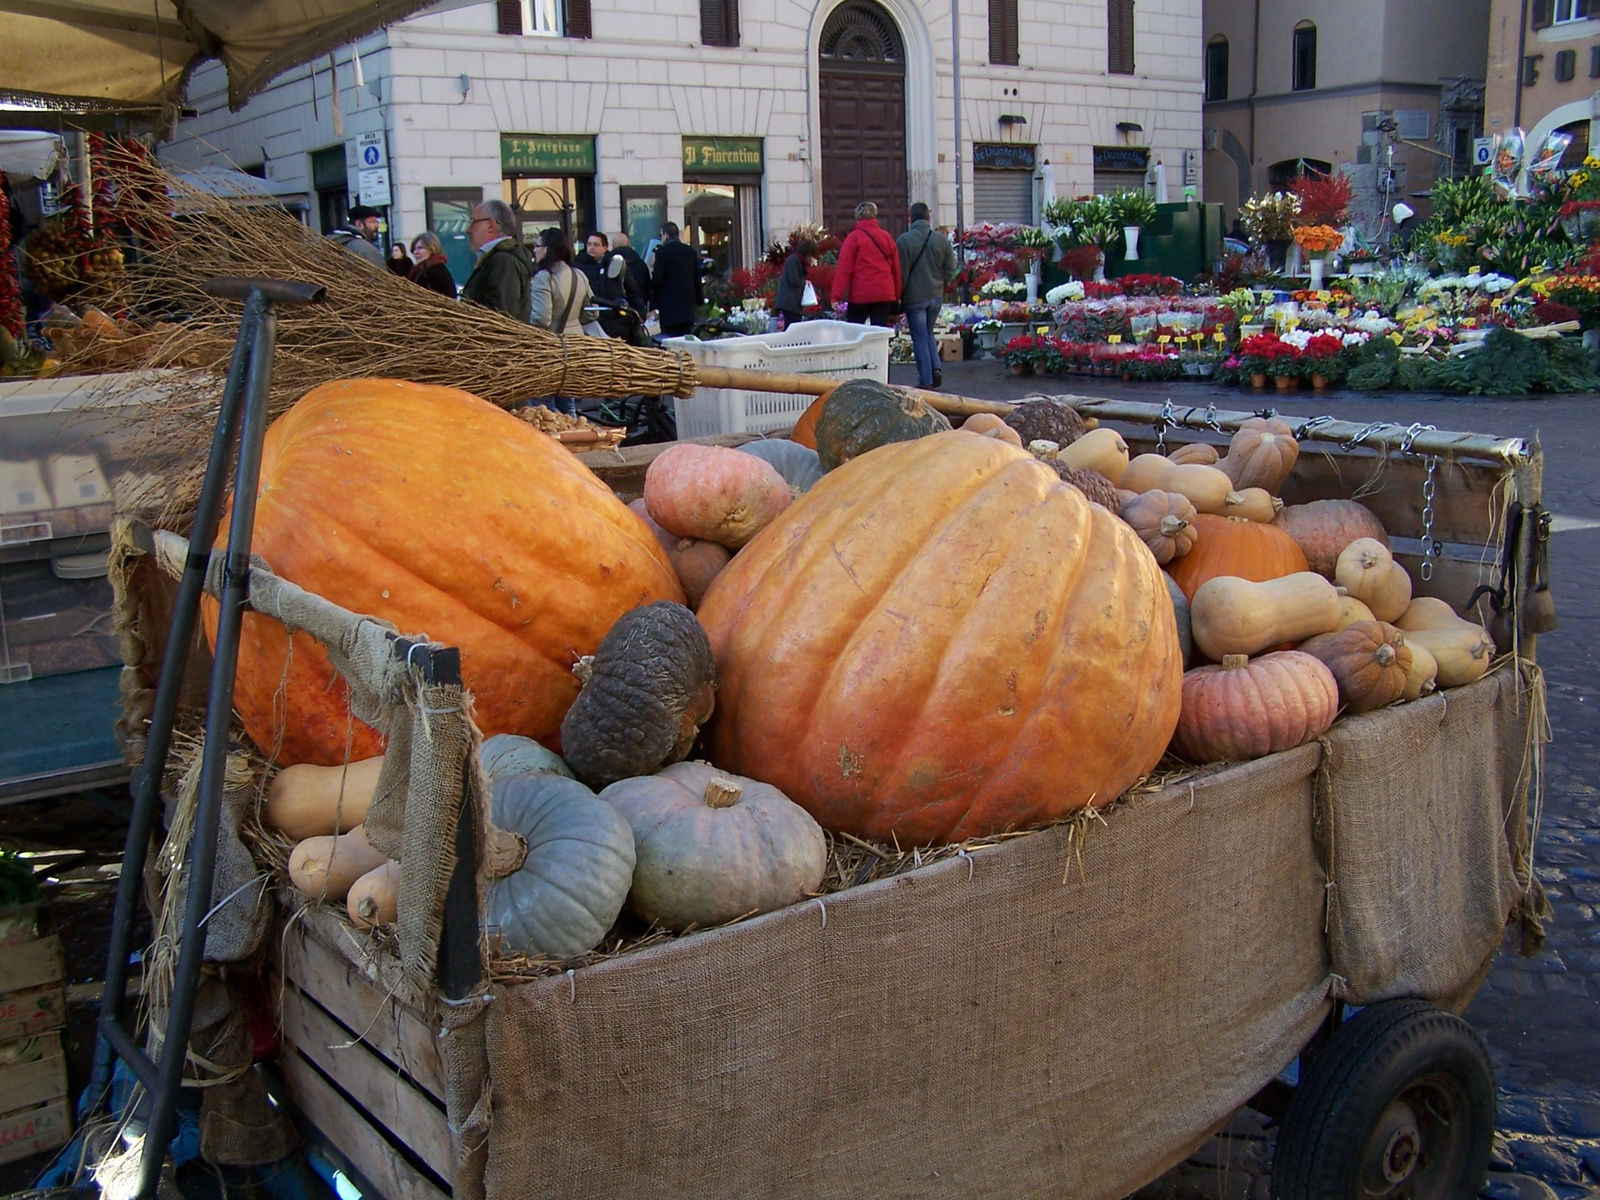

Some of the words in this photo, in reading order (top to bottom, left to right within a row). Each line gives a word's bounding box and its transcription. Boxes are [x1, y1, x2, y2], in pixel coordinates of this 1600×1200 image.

[512, 140, 581, 154] L'Artigiano
[685, 145, 696, 165] Il
[702, 145, 759, 165] Fiorentino
